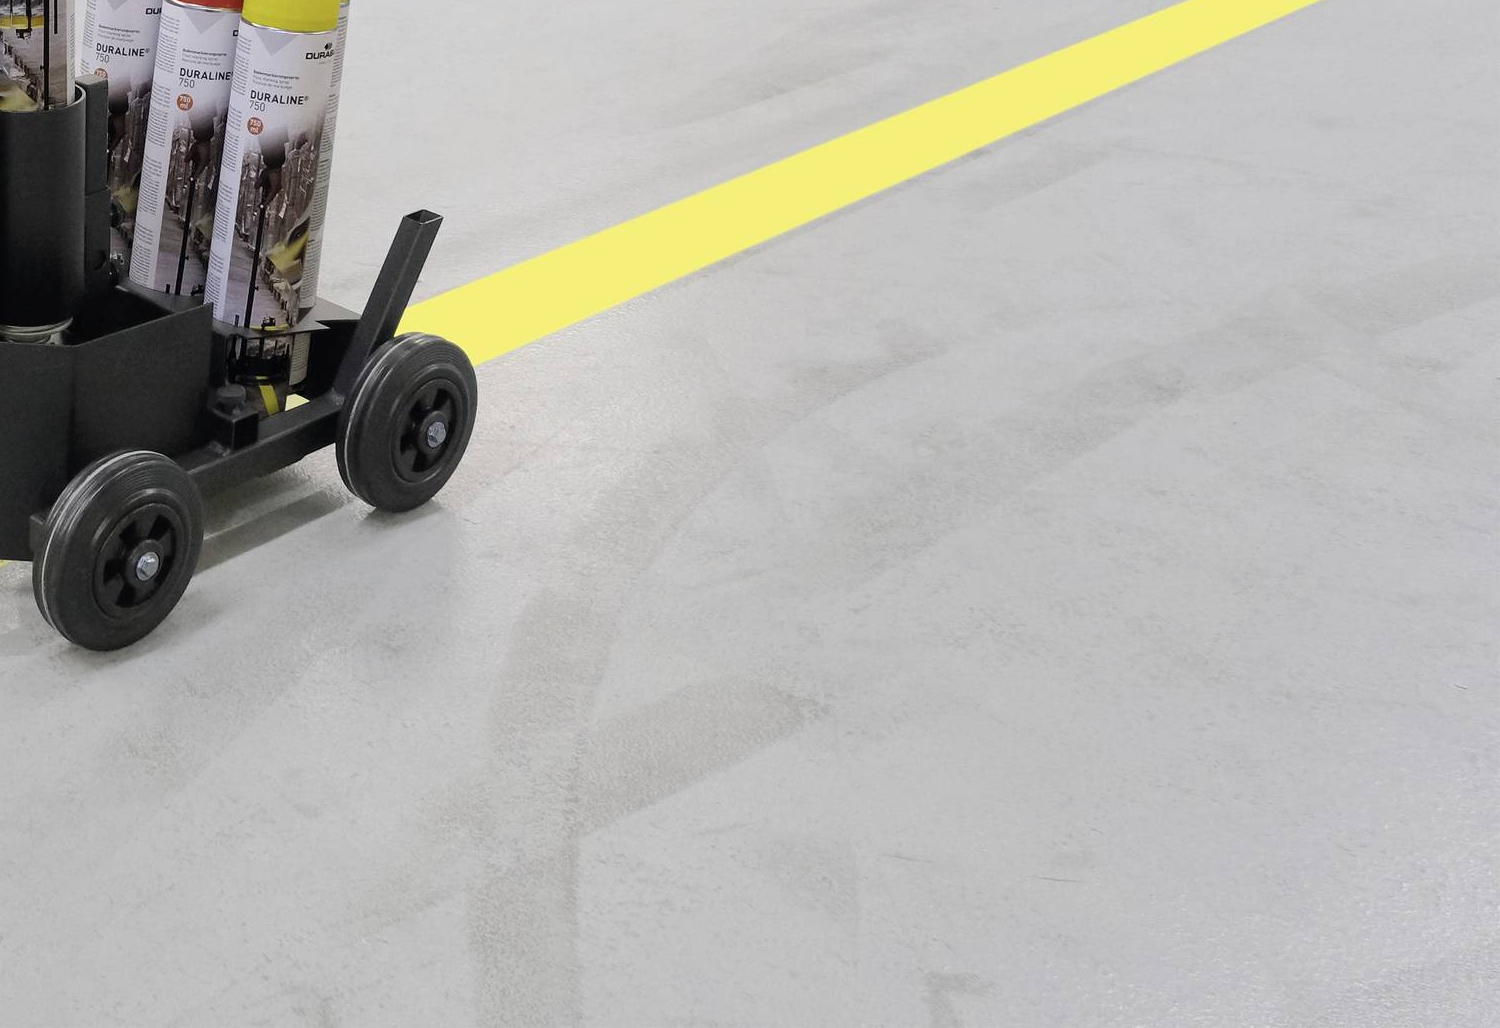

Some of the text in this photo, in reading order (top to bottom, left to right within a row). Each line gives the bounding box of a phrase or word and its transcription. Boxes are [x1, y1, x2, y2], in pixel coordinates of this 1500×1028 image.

[95, 52, 110, 63] 750
[179, 78, 195, 89] 750
[249, 100, 266, 112] 750
